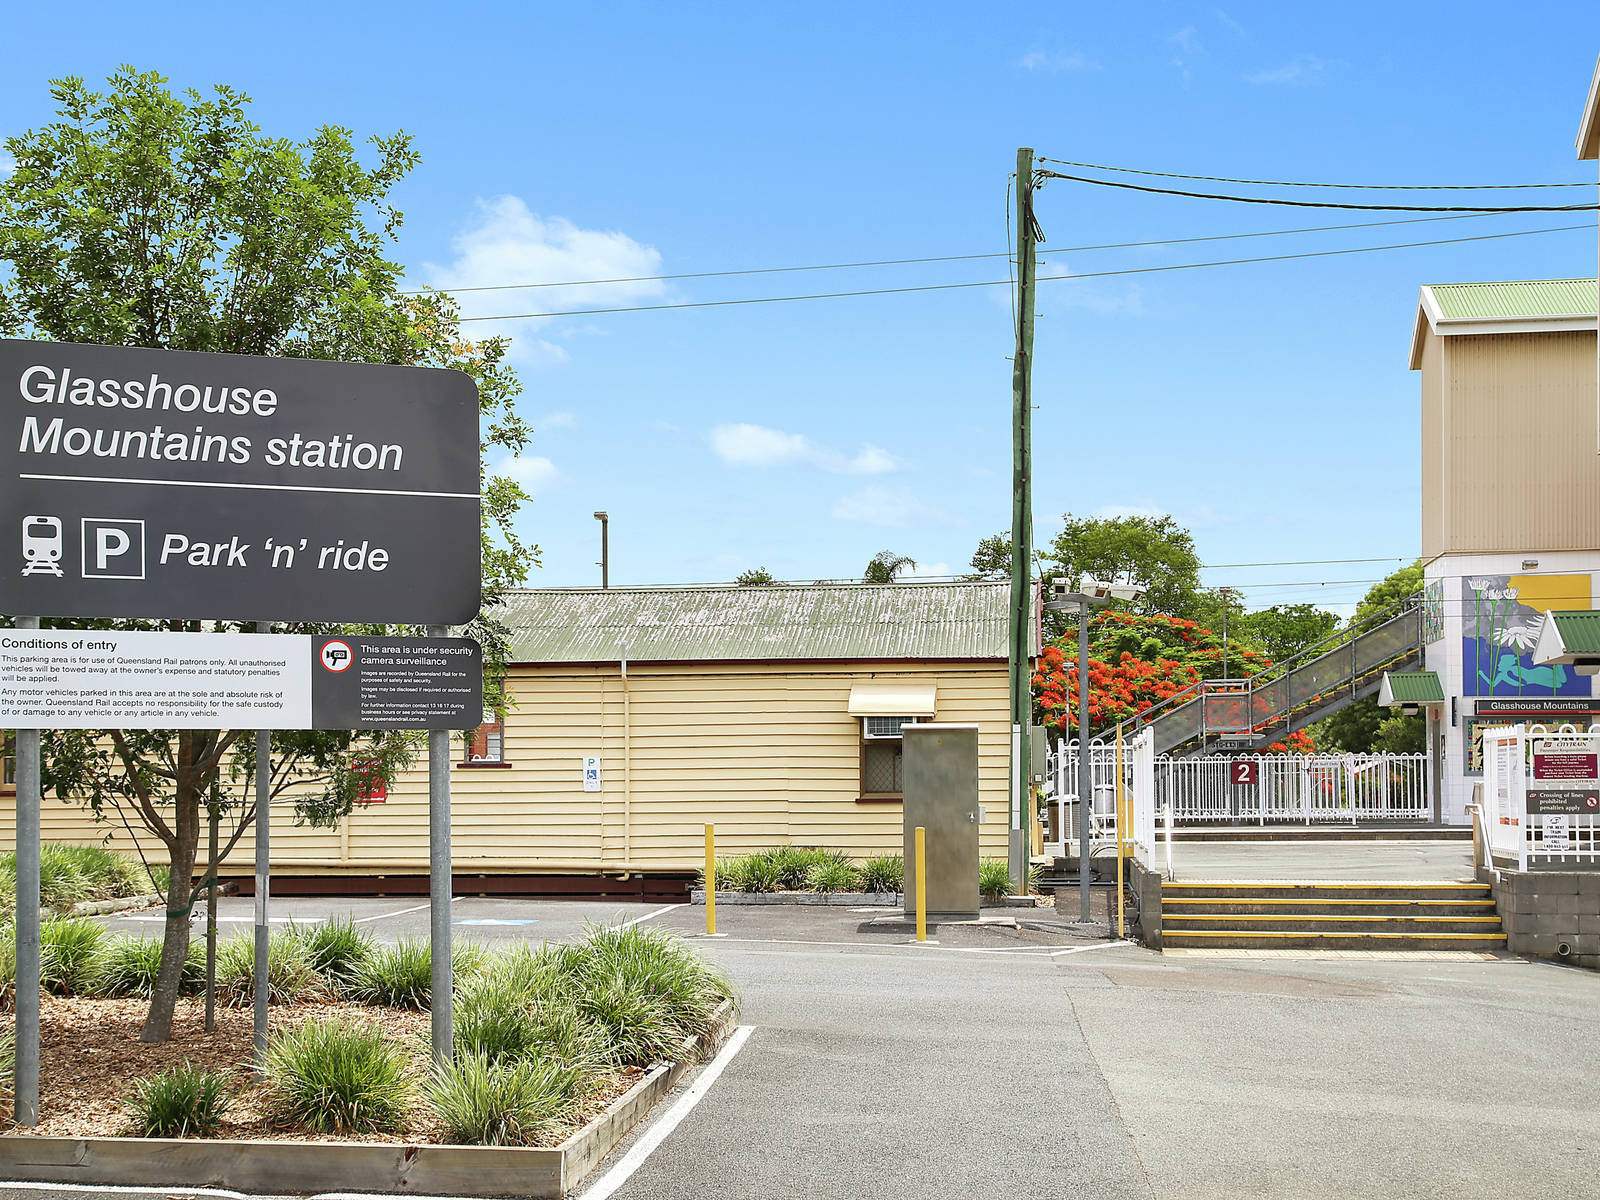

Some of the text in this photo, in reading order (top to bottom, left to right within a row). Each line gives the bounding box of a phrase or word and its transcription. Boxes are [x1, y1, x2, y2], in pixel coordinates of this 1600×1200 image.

[20, 365, 277, 416] Glasshouse
[19, 416, 403, 471] Mountains station
[96, 527, 130, 569] P
[160, 534, 250, 567] Park
[318, 540, 389, 571] ride
[1, 637, 117, 653] Conditions of entry
[360, 644, 473, 657] This area is under security
[1, 654, 19, 663] This
[19, 655, 50, 665] parking
[70, 656, 77, 664] is
[78, 656, 90, 664] for
[106, 656, 116, 664] of
[116, 656, 162, 665] Queensland
[163, 657, 178, 665] Rail
[179, 659, 208, 667] patrons
[209, 658, 227, 668] only.
[227, 659, 238, 667] All
[239, 659, 286, 667] unauthorised
[360, 656, 447, 666] camera surveillance
[1, 664, 34, 673] vehicles
[35, 665, 48, 673] will
[49, 665, 61, 673] be
[62, 666, 87, 674] towed
[88, 667, 109, 675] away
[119, 666, 132, 674] the
[164, 668, 197, 676] expense
[213, 668, 247, 678] statutory
[247, 669, 281, 677] penalties
[1, 674, 60, 684] will be applied.
[1, 688, 18, 697] Any
[45, 688, 78, 697] vehicles
[80, 689, 108, 698] parked
[109, 689, 117, 697] in
[118, 689, 134, 697] this
[168, 690, 176, 698] at
[177, 690, 191, 698] the
[191, 690, 208, 698] sole
[209, 690, 225, 698] and
[225, 690, 259, 700] absolute
[260, 691, 274, 699] risk
[274, 691, 283, 699] of
[1, 698, 15, 706] the
[16, 697, 44, 706] owner.
[45, 698, 94, 707] Queensland
[95, 698, 111, 707] Rail
[112, 699, 144, 708] accepts
[157, 699, 208, 709] responsibility
[209, 699, 220, 708] for
[221, 700, 235, 708] the
[235, 700, 252, 708] safe
[253, 701, 284, 710] custody
[1490, 701, 1589, 711] Glasshouse Mountains
[1, 707, 10, 716] of
[22, 708, 56, 718] damage
[57, 709, 66, 718] to
[67, 709, 83, 718] any
[84, 708, 112, 717] vehicle
[123, 710, 139, 718] any
[140, 709, 164, 717] article
[165, 709, 173, 717] in
[174, 710, 189, 719] any
[190, 709, 220, 717] vehicle.
[1237, 764, 1250, 782] 2
[1539, 797, 1567, 805] prohibited
[1539, 804, 1580, 812] penalties apply
